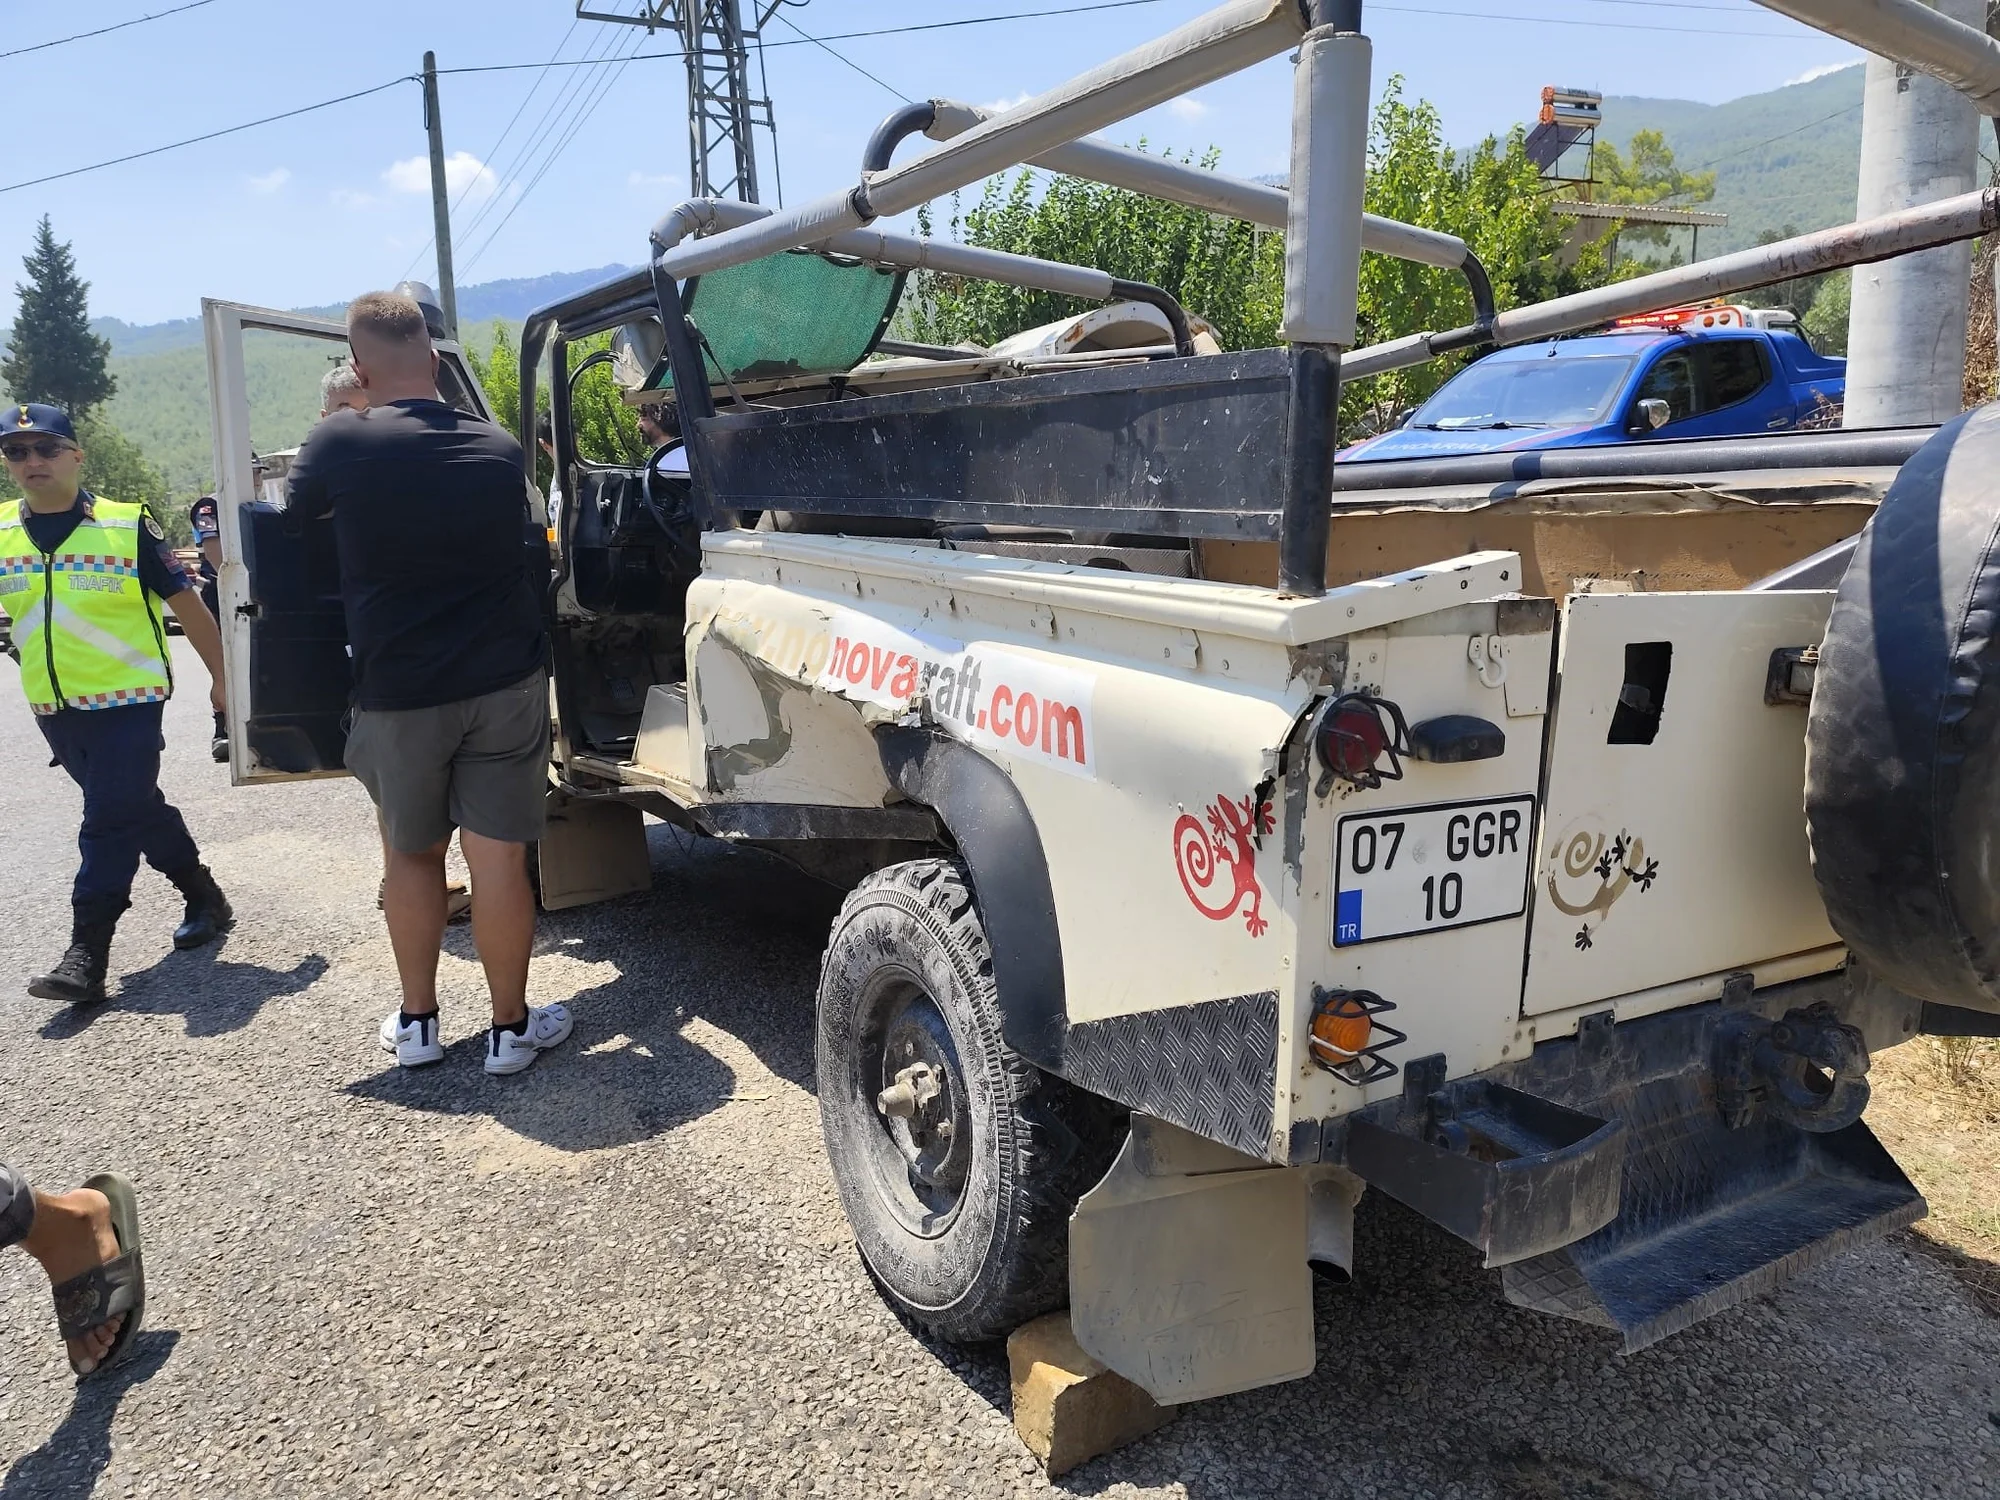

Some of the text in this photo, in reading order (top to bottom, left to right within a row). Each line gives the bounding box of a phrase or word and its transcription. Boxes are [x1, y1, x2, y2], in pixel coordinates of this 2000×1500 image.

[68, 574, 125, 594] TRAFIK
[1352, 809, 1521, 874] 07 GGR
[1422, 872, 1463, 921] 10
[1339, 923, 1357, 939] TR
